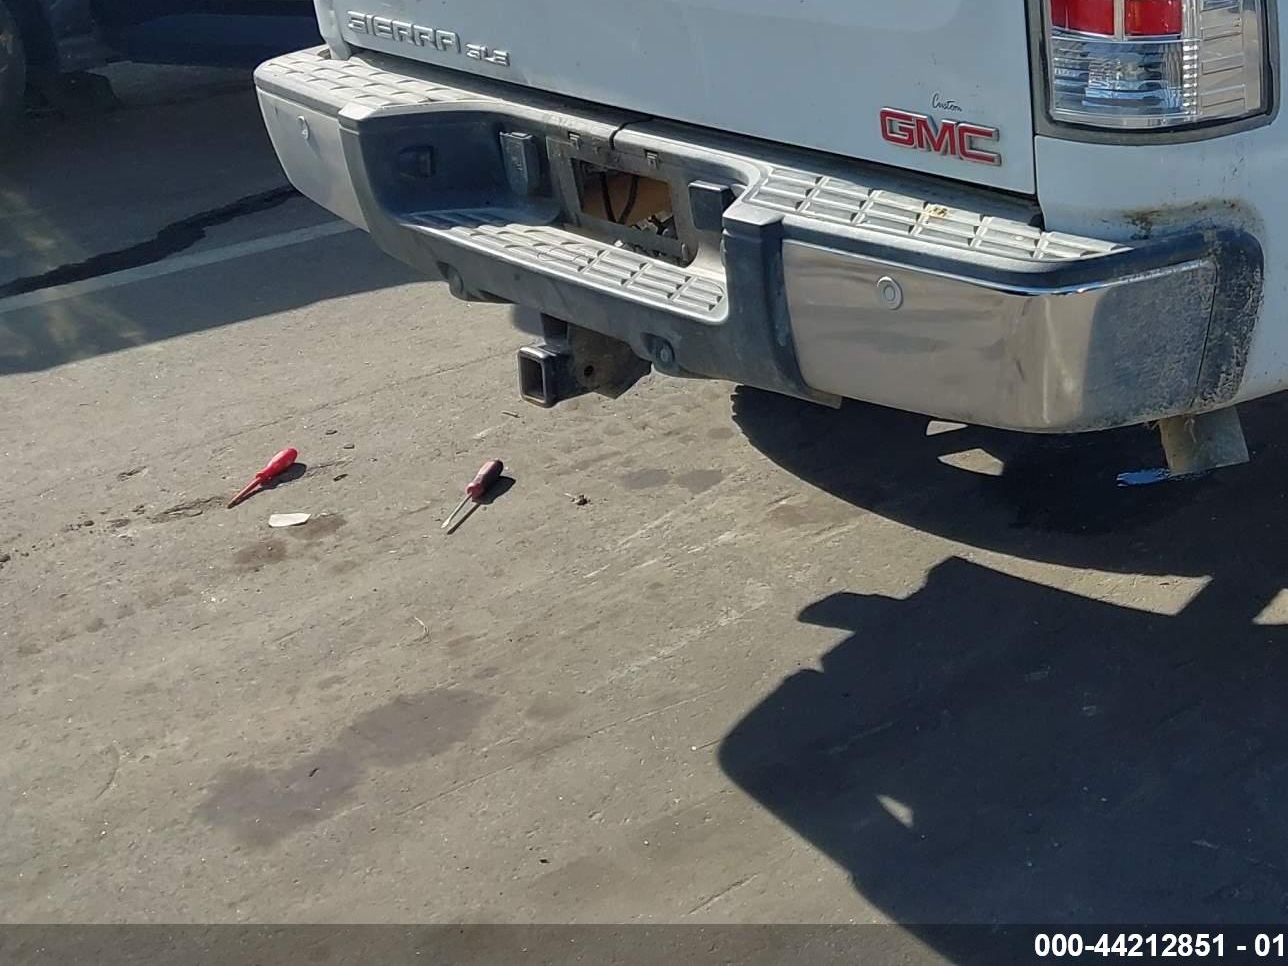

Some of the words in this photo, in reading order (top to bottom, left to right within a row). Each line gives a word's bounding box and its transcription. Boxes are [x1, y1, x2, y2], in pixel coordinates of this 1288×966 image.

[347, 10, 461, 54] SIERRA
[932, 92, 962, 112] Custom
[880, 106, 1002, 167] GMC
